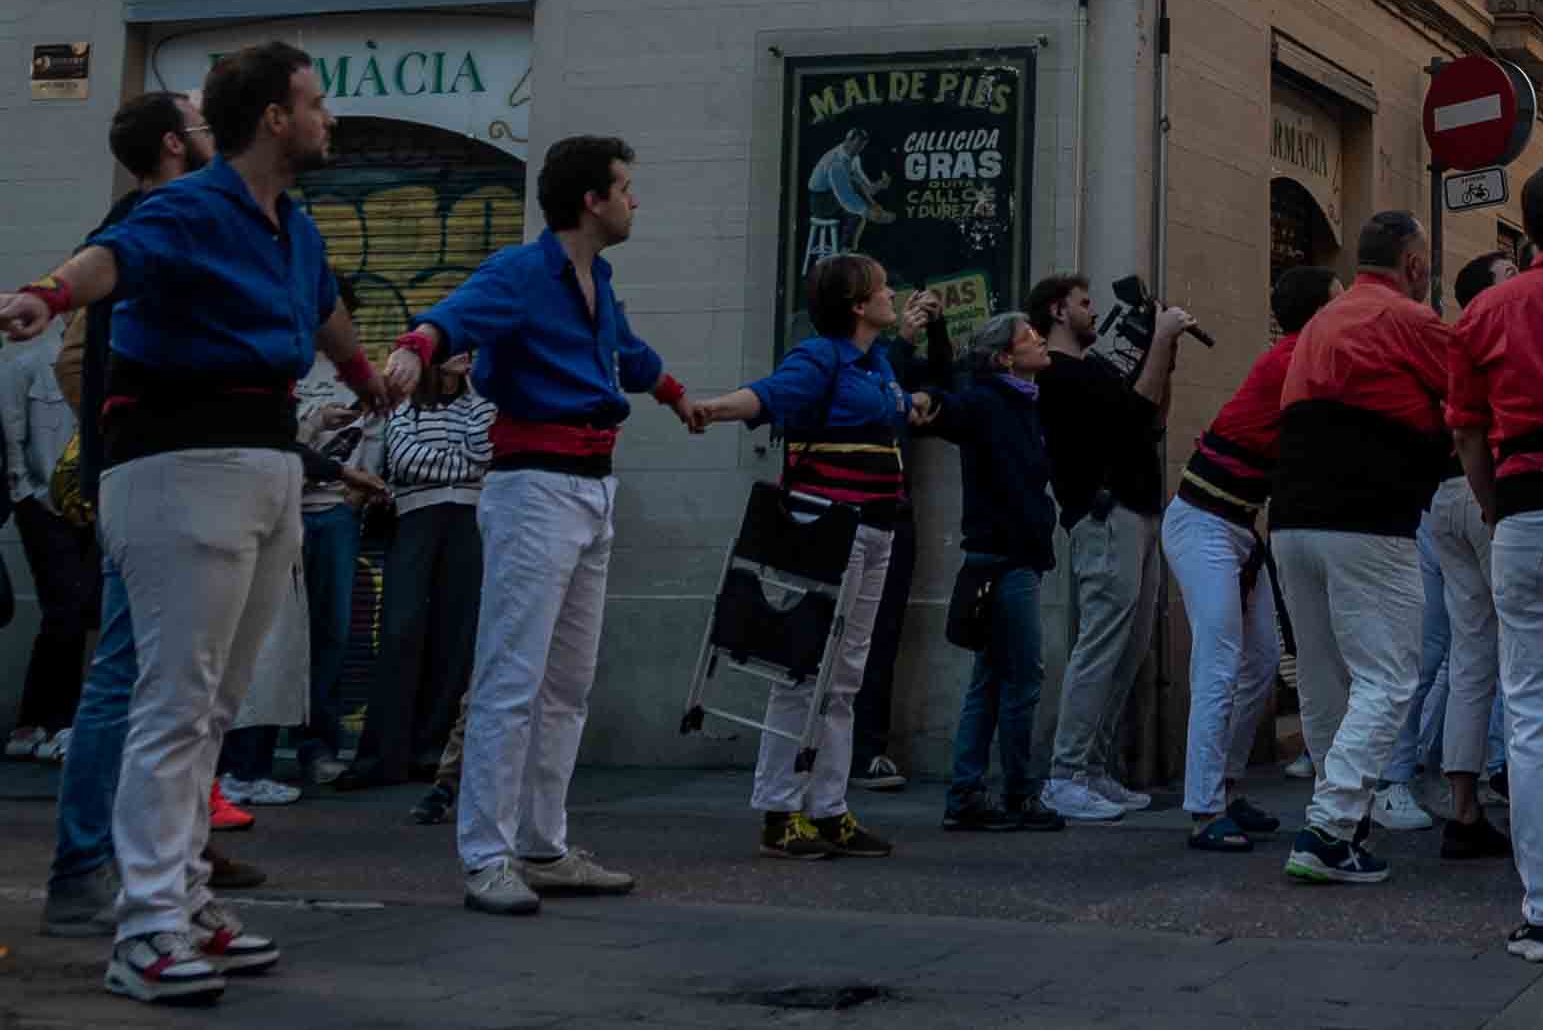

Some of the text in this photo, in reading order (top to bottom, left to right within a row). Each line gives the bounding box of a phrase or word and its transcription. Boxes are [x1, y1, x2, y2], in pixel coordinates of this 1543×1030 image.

[808, 71, 1012, 124] MAL DE PIES
[903, 127, 1001, 153] CALLICIDA
[1270, 117, 1329, 178] RMÀCIA
[904, 150, 1003, 181] GRAS
[905, 204, 916, 219] Y
